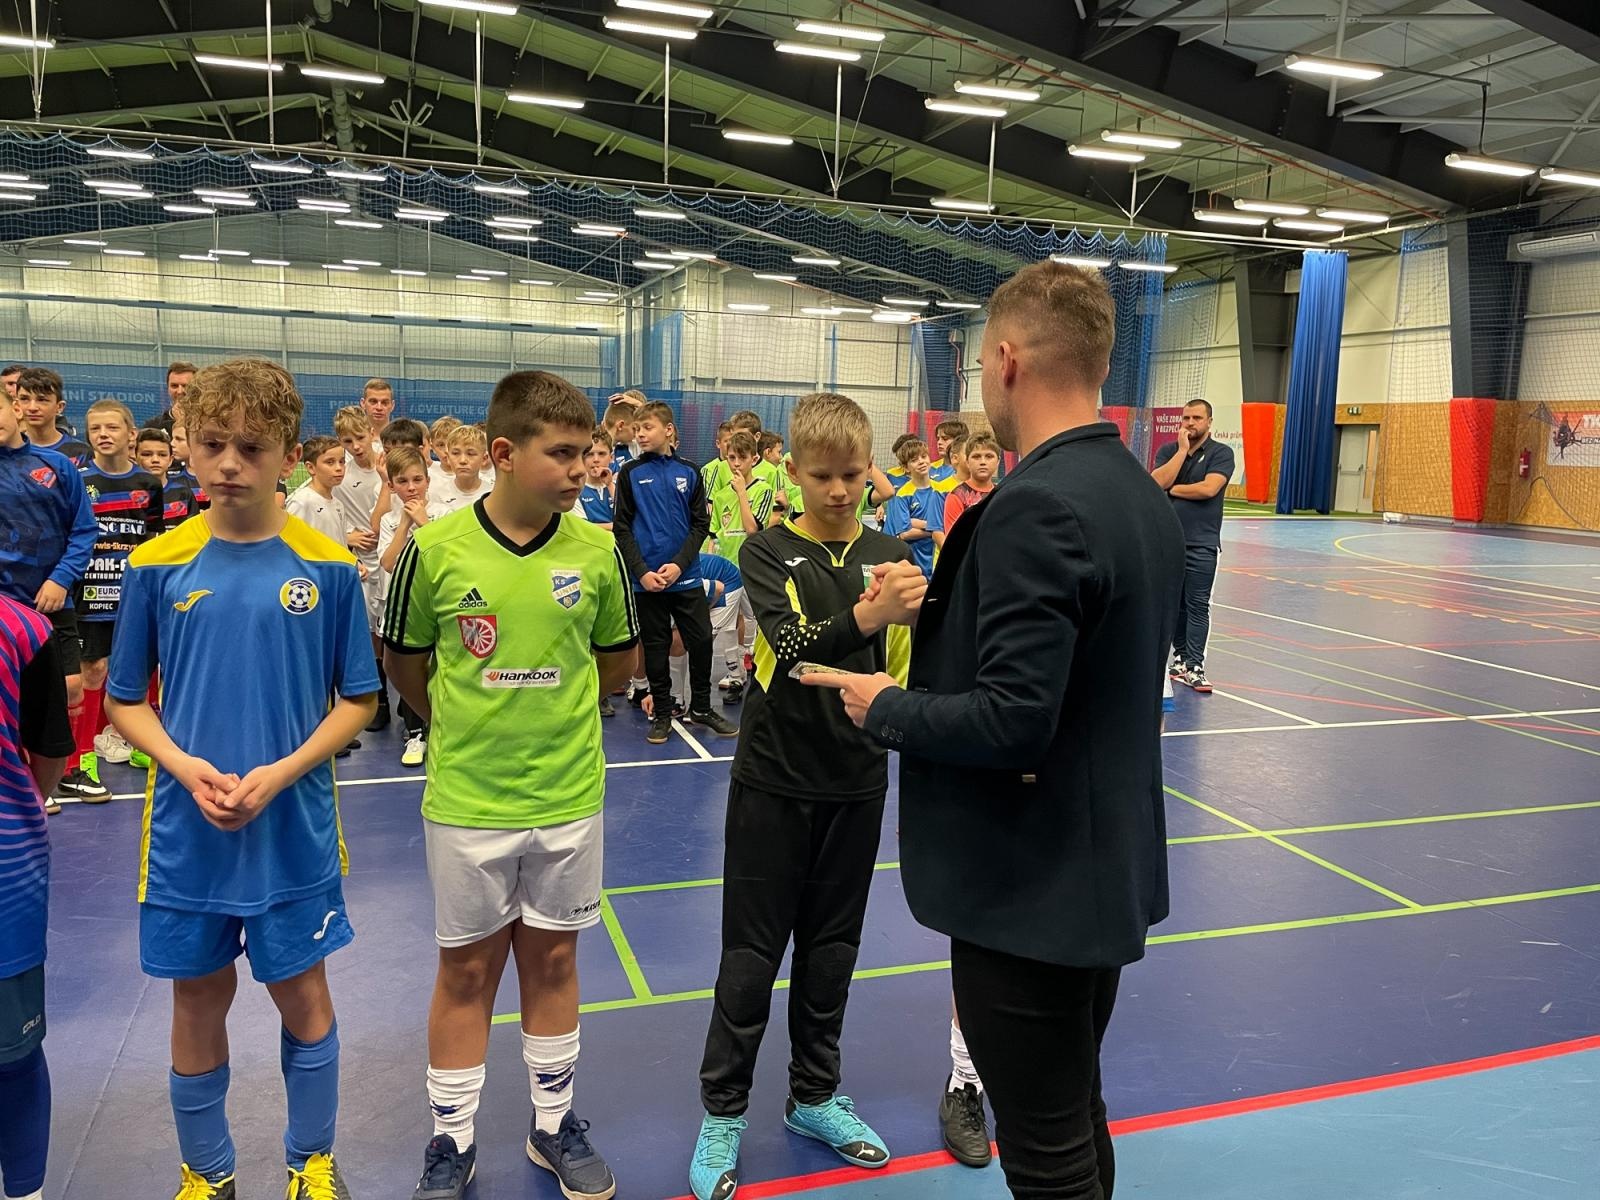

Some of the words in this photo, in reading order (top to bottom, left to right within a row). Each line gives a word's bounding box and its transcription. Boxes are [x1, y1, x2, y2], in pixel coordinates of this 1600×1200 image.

[88, 390, 155, 403] STADION
[84, 572, 114, 580] CENTRUM
[89, 602, 113, 610] KOPIEC
[458, 599, 488, 609] adidas
